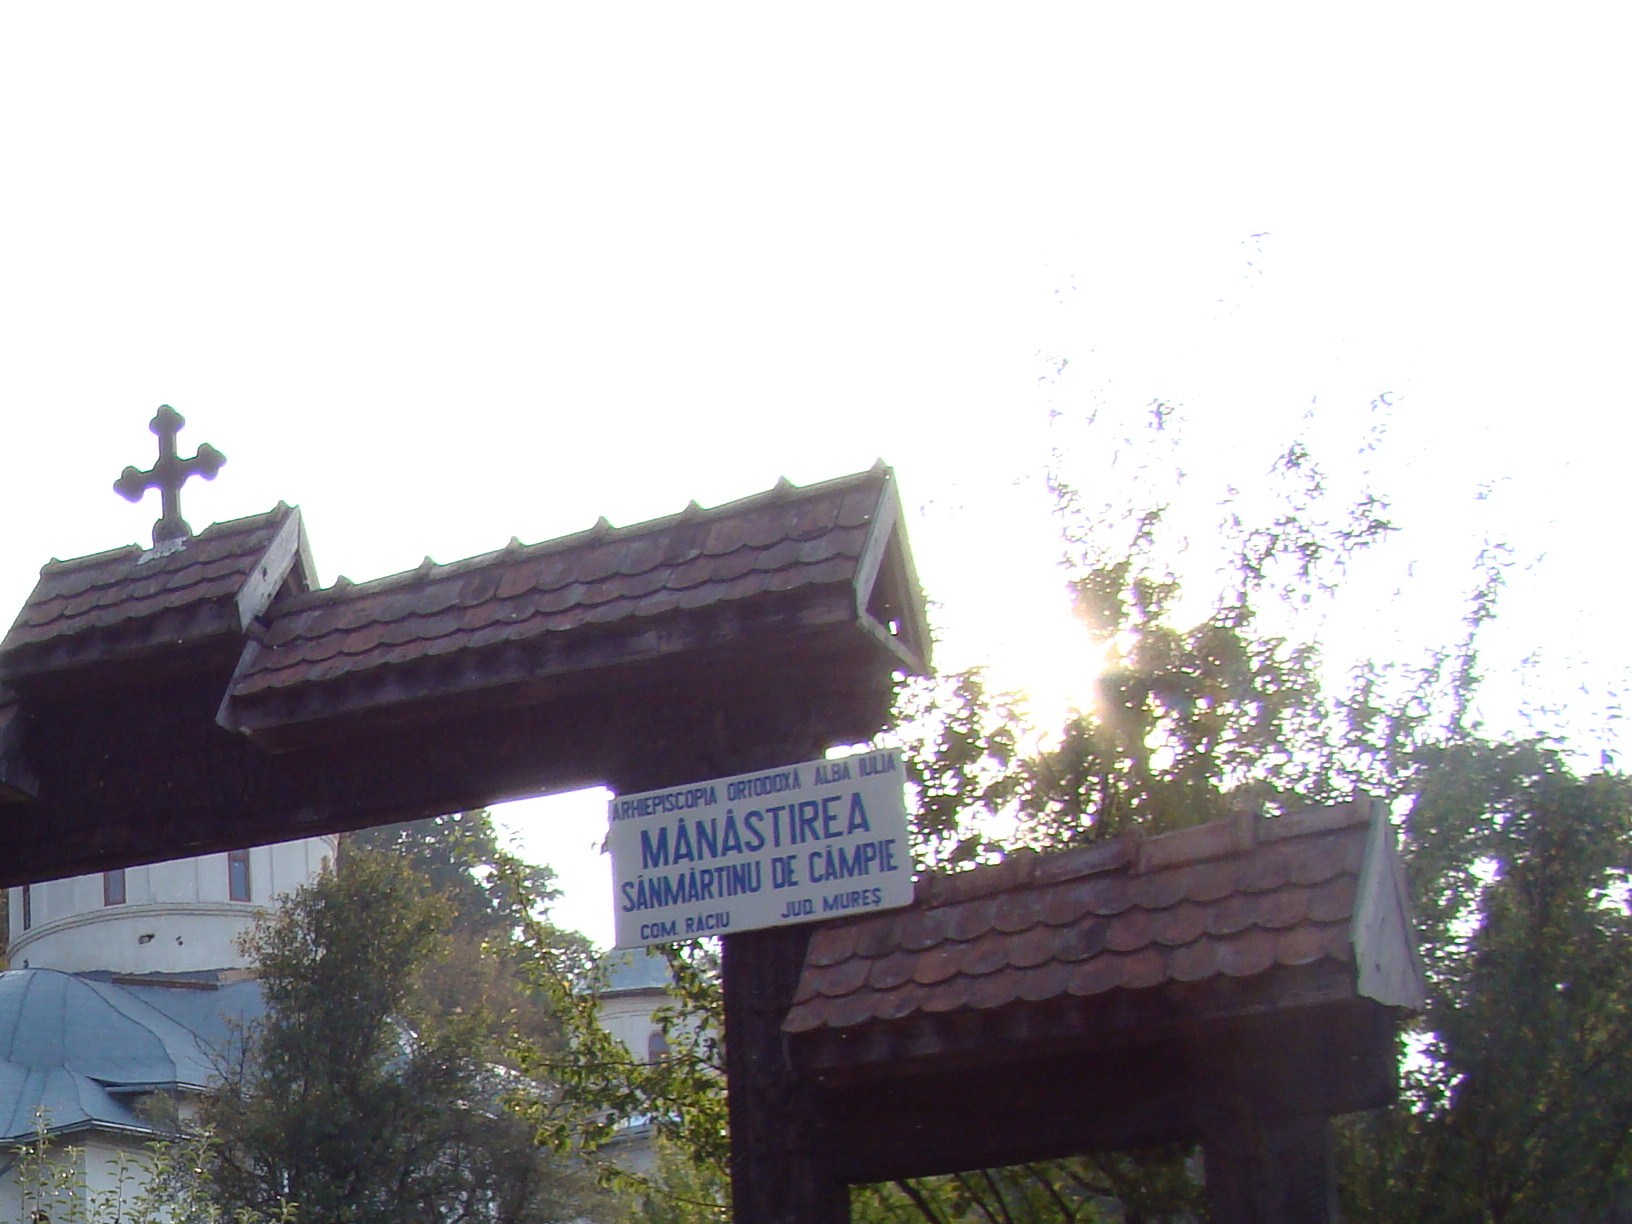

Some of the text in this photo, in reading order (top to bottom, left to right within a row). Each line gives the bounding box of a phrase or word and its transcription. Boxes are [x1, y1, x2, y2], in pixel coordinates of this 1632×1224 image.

[612, 786, 717, 821] ARHIEPISCOPIA
[813, 761, 852, 786] ALBA
[771, 854, 798, 889] DE
[808, 838, 898, 884] CÂMPIE
